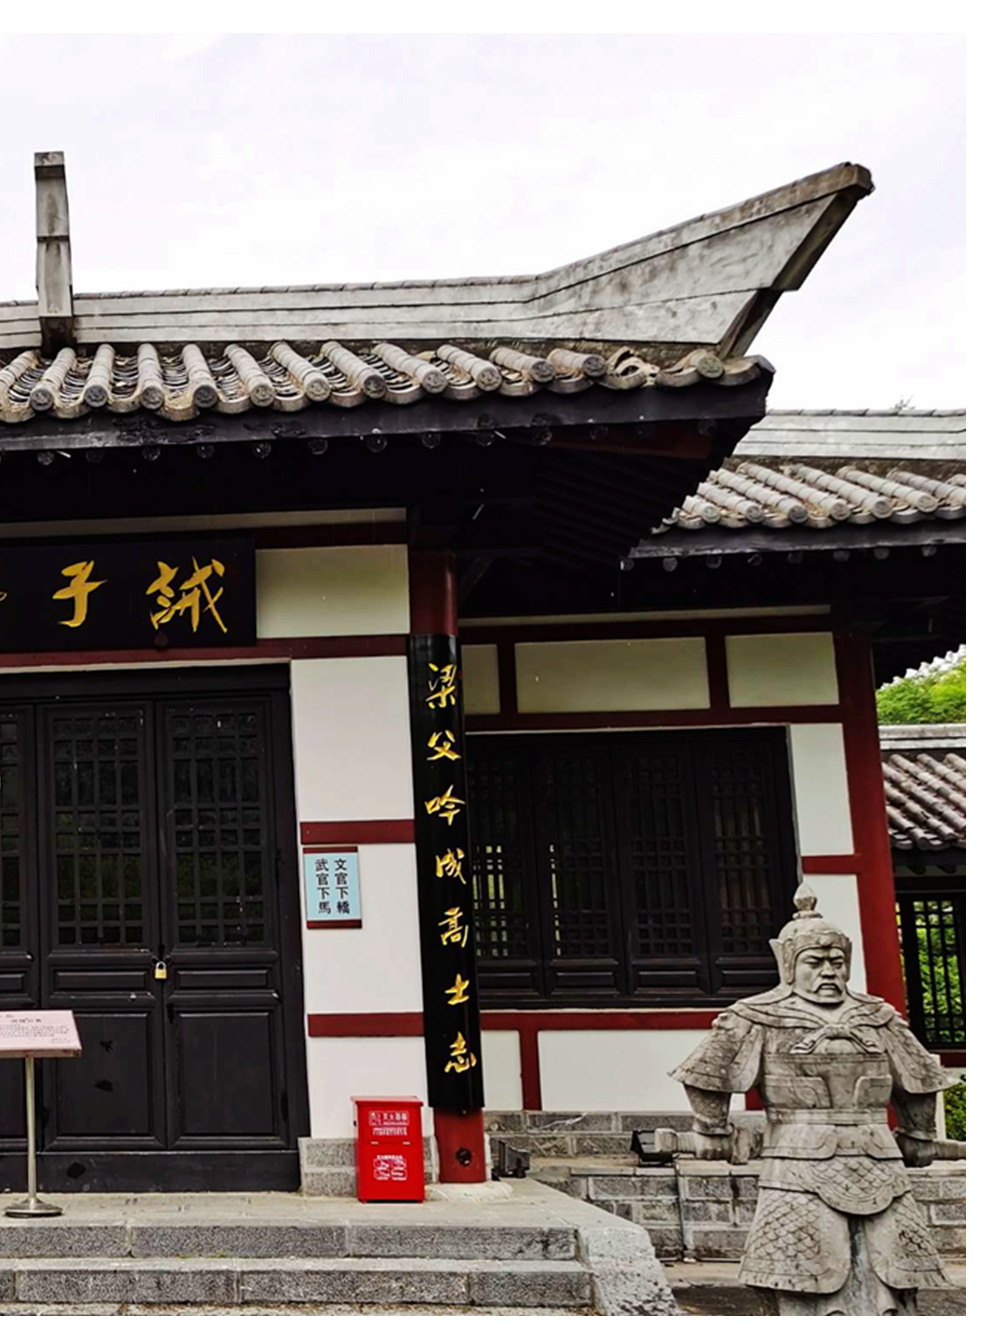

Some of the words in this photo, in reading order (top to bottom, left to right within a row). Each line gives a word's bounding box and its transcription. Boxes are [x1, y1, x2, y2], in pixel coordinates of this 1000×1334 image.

[315, 858, 331, 915] 武官下馬
[425, 662, 477, 1074] 梁父吟成高士志
